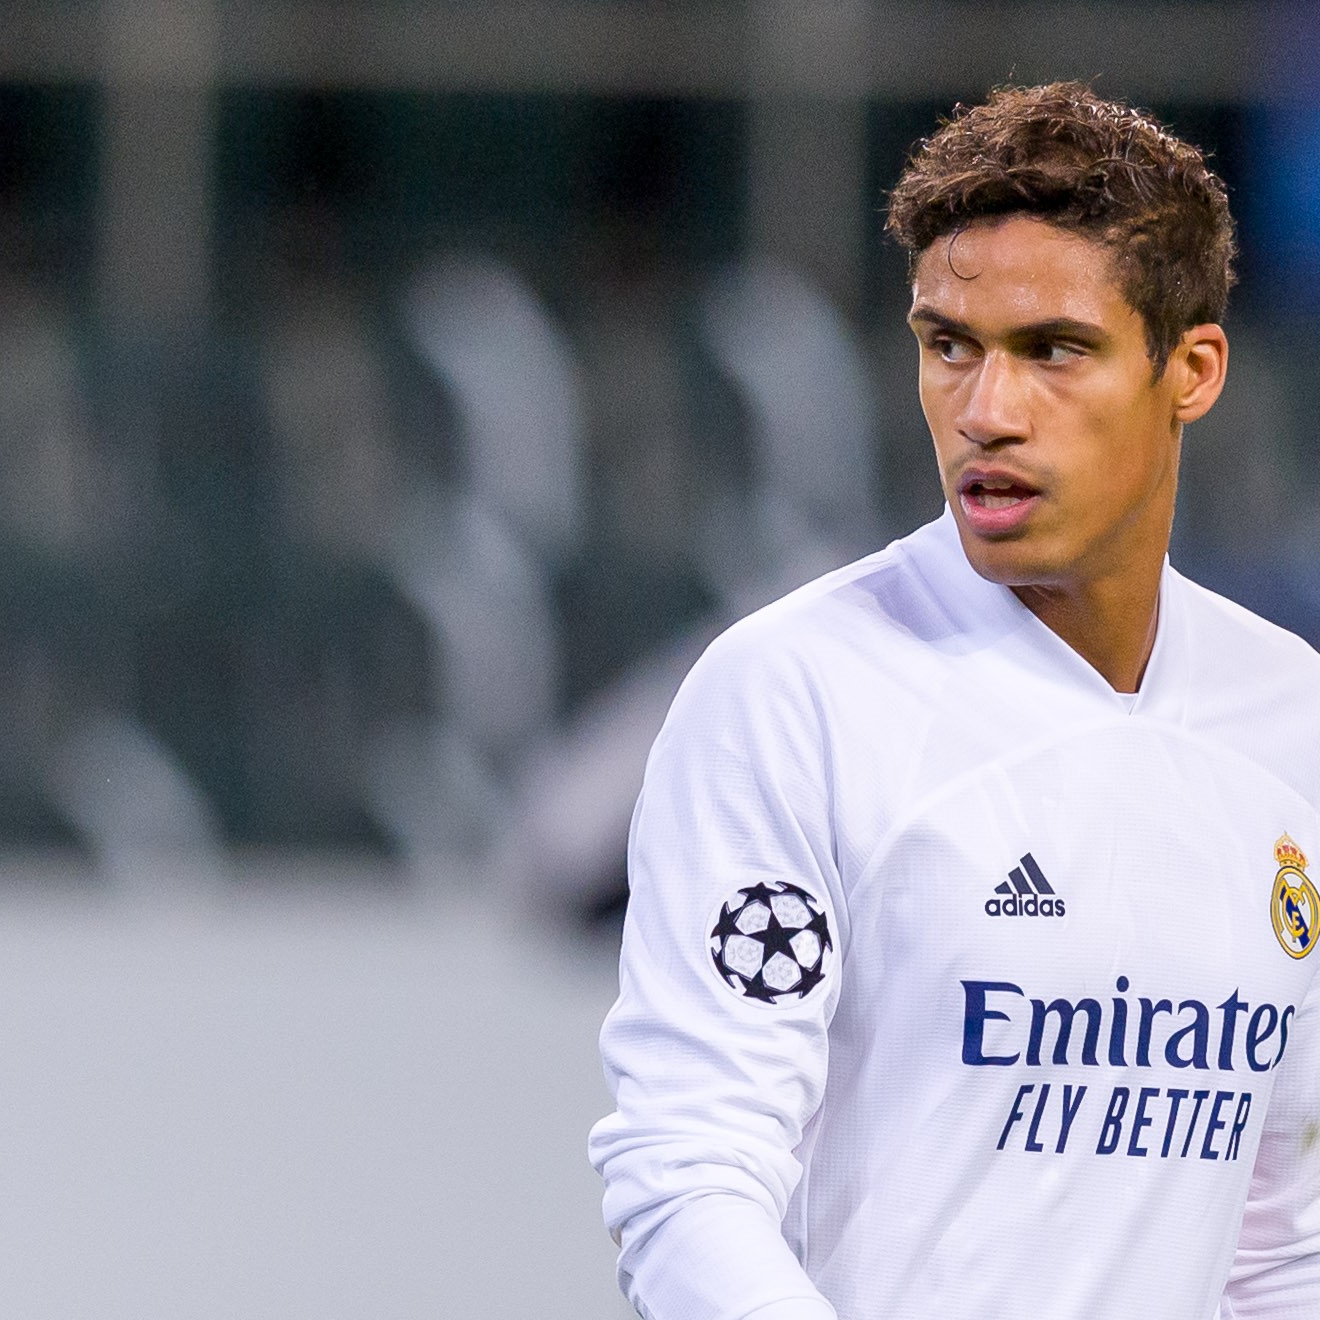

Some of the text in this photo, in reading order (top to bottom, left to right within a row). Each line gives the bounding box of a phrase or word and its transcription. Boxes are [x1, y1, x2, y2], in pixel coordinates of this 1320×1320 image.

[984, 893, 1066, 917] adidas
[959, 975, 1296, 1073] Emirates
[996, 1083, 1252, 1161] FLY BETTER
